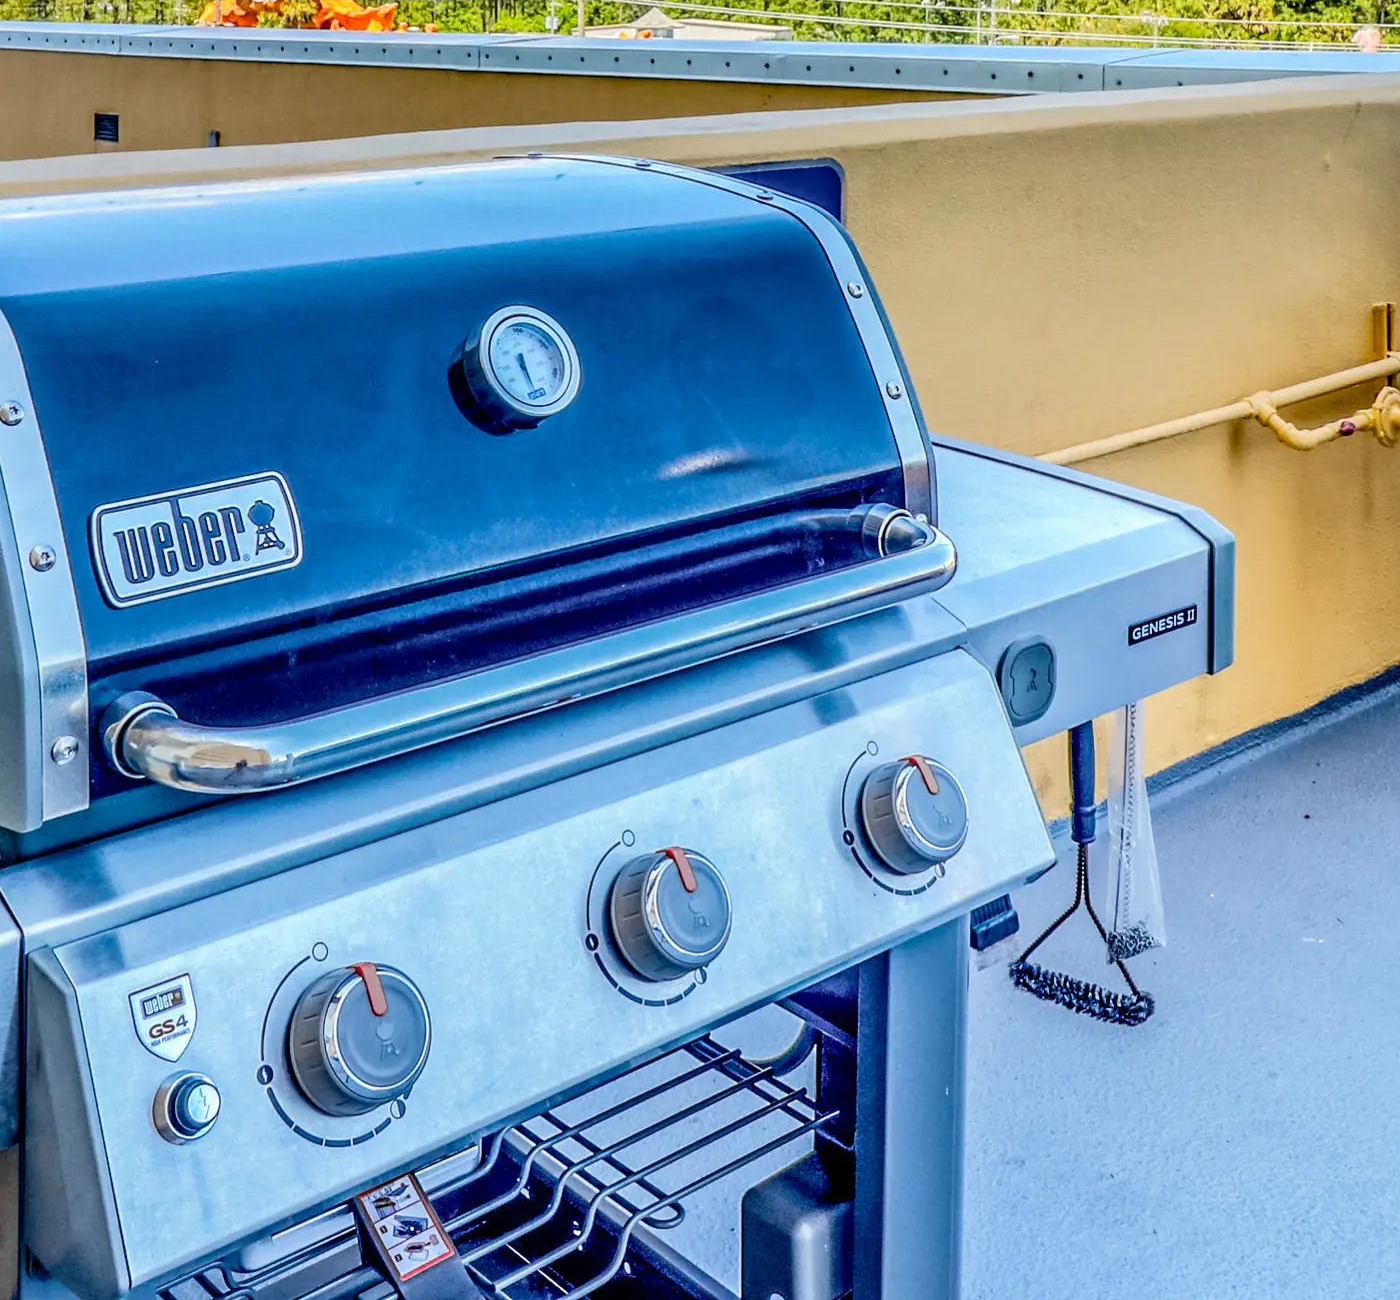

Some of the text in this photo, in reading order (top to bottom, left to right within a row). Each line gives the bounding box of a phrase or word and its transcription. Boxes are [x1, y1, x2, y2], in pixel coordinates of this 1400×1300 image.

[113, 499, 245, 584] weber
[1132, 608, 1195, 640] GENESIS II
[144, 993, 174, 1015] weber
[149, 1014, 189, 1039] GS4
